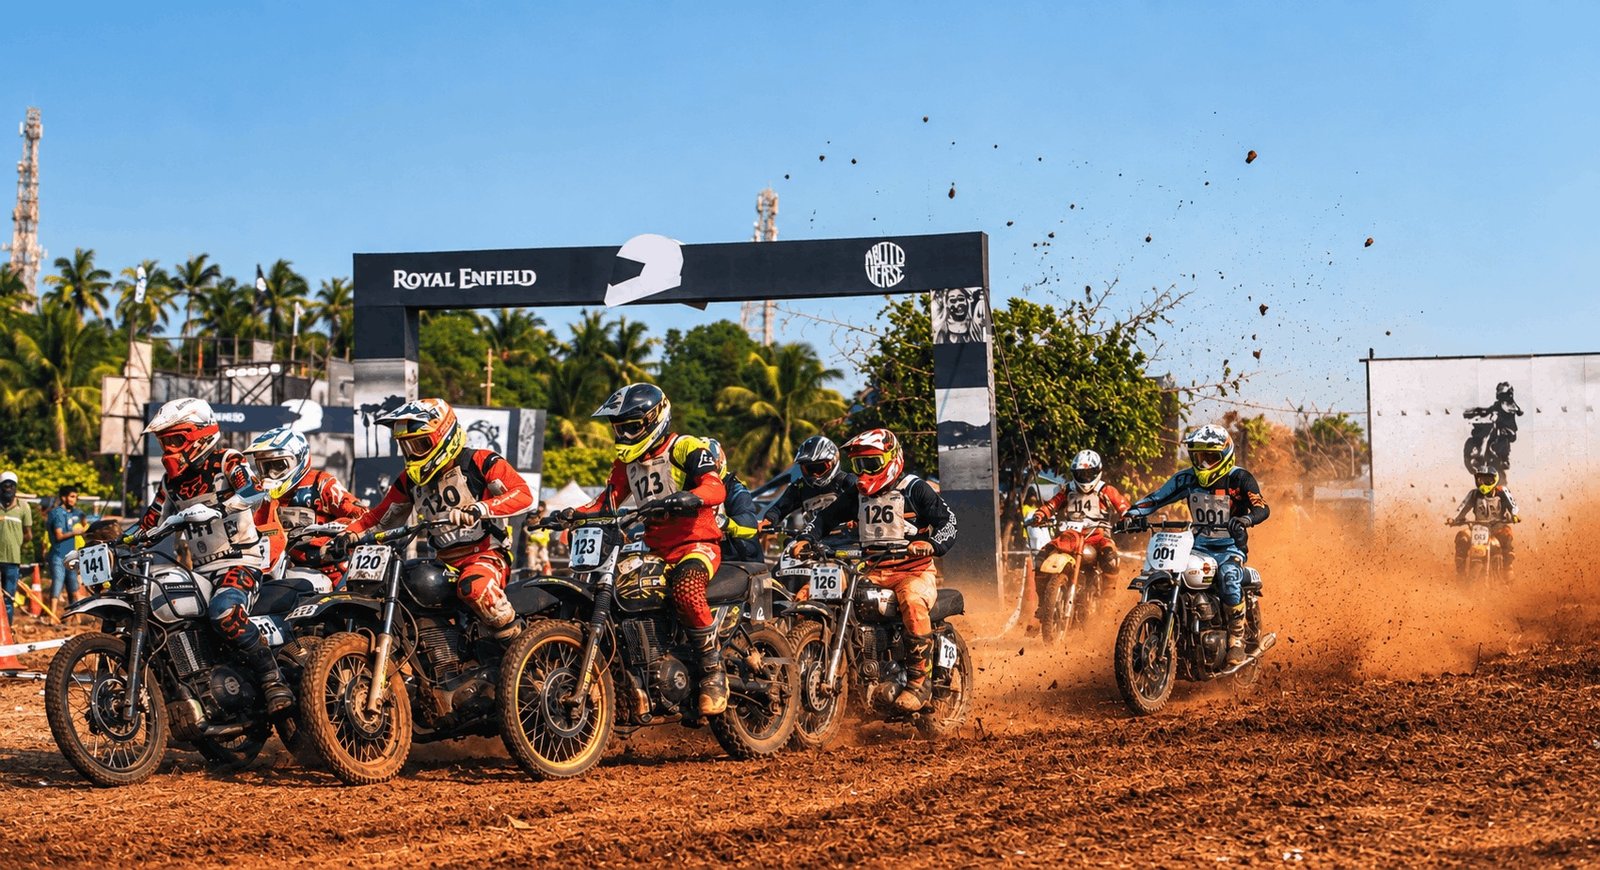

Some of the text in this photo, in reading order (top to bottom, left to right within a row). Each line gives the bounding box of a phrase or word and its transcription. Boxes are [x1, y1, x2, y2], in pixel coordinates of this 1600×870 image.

[393, 268, 537, 290] ROYAL ENFIELD
[634, 471, 664, 501] 123
[422, 485, 461, 516] 120
[1073, 499, 1092, 513] 114
[864, 505, 894, 525] 126
[1196, 508, 1225, 525] 001
[575, 538, 596, 556] 123
[1153, 547, 1175, 561] 001
[83, 555, 104, 574] 141
[356, 554, 381, 570] 120
[813, 576, 837, 590] 126
